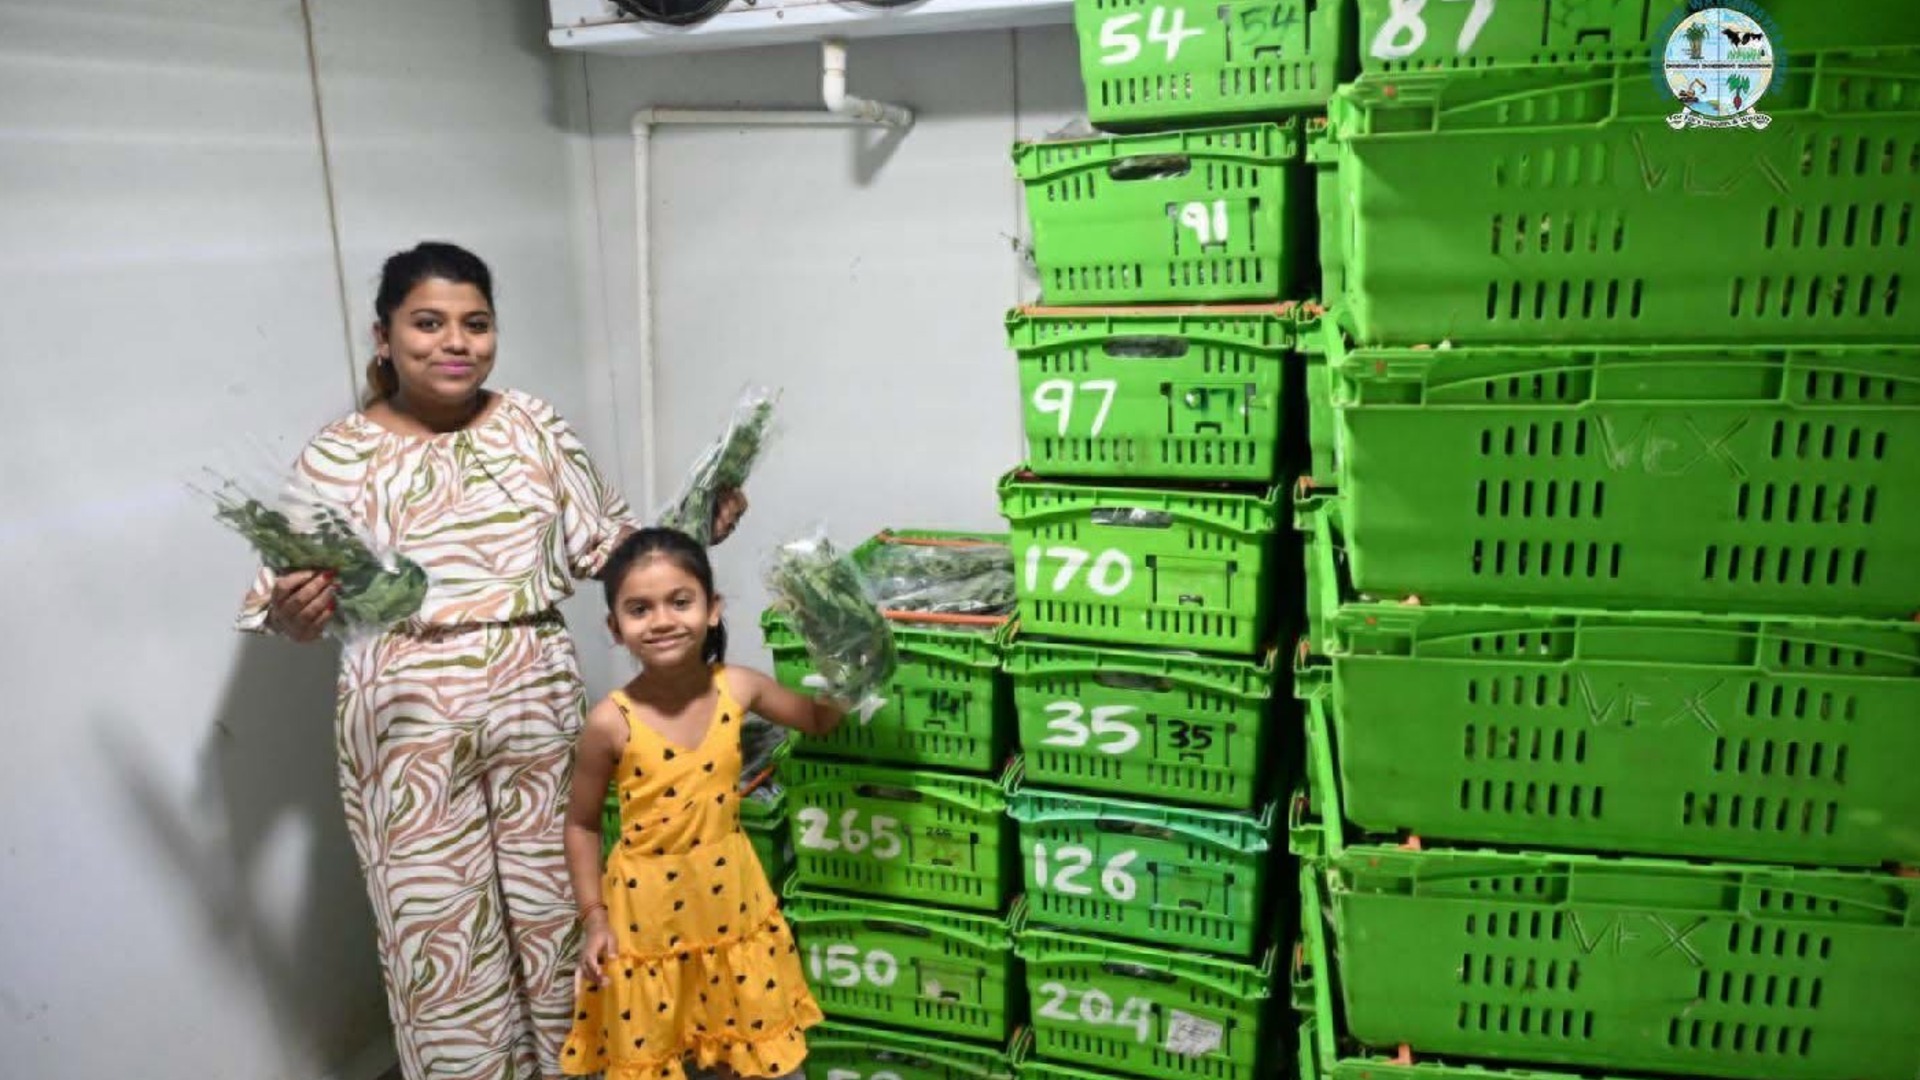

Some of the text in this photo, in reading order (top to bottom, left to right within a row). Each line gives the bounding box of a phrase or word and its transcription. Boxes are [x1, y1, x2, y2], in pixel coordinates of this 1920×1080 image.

[1099, 6, 1205, 64] 54
[1241, 4, 1302, 45] 54
[1369, 0, 1497, 59] 87
[1180, 199, 1229, 244] 91
[1033, 378, 1118, 437] 97
[1025, 544, 1133, 596] 170
[1040, 700, 1141, 754] 35
[1167, 719, 1214, 750] 35
[797, 807, 900, 860] 265
[1034, 843, 1138, 901] 126
[809, 942, 898, 987] 150
[1037, 981, 1151, 1044] 204
